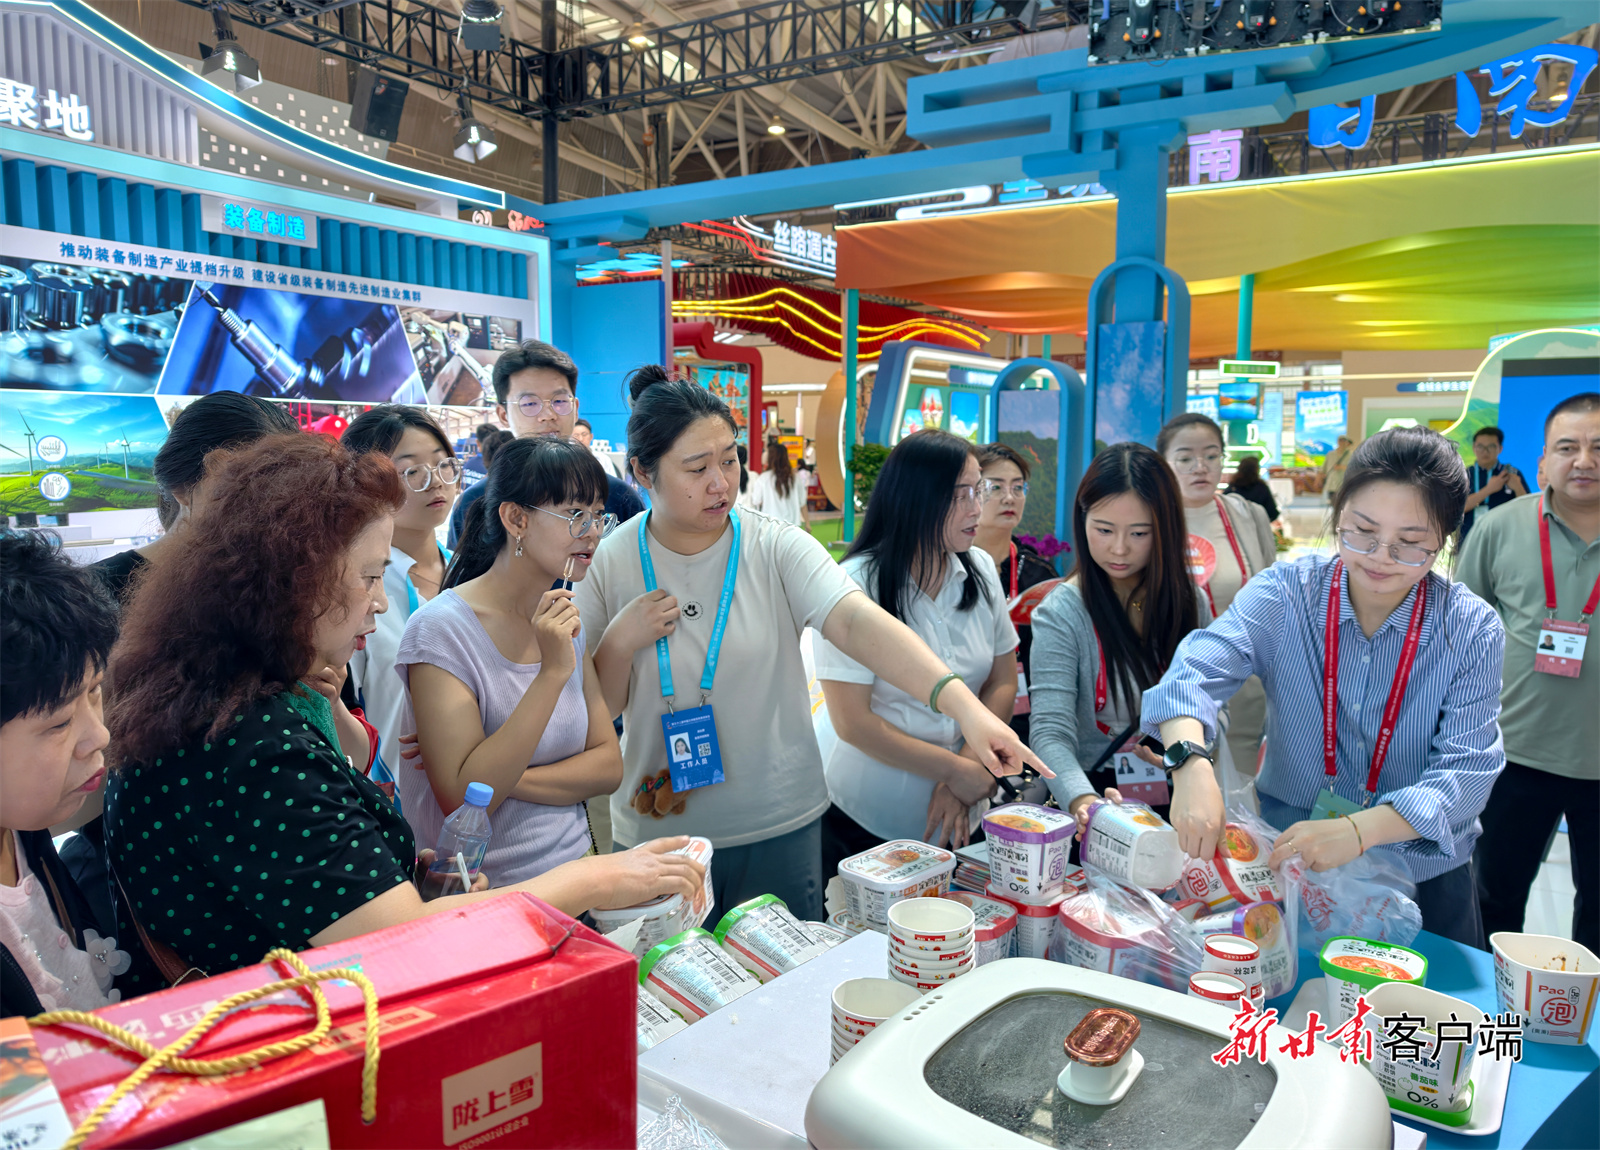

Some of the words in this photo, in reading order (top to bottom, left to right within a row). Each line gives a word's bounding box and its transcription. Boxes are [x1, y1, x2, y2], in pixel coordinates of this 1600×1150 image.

[0, 77, 94, 142] 聚地
[1188, 129, 1244, 184] 南
[224, 203, 307, 240] 装备制造
[773, 219, 838, 266] 丝路通古
[59, 241, 246, 280] 推动装备制造产业提档升级
[251, 268, 422, 303] 建设省级装备制造先进制造业集群
[680, 757, 708, 769] 工作人员
[1009, 882, 1030, 895] 0%
[1538, 985, 1565, 996] Pao
[1543, 999, 1575, 1026] 泡
[1410, 1072, 1438, 1087] 番茄味
[453, 1076, 534, 1130] 陇上雪
[1407, 1091, 1438, 1109] 0%
